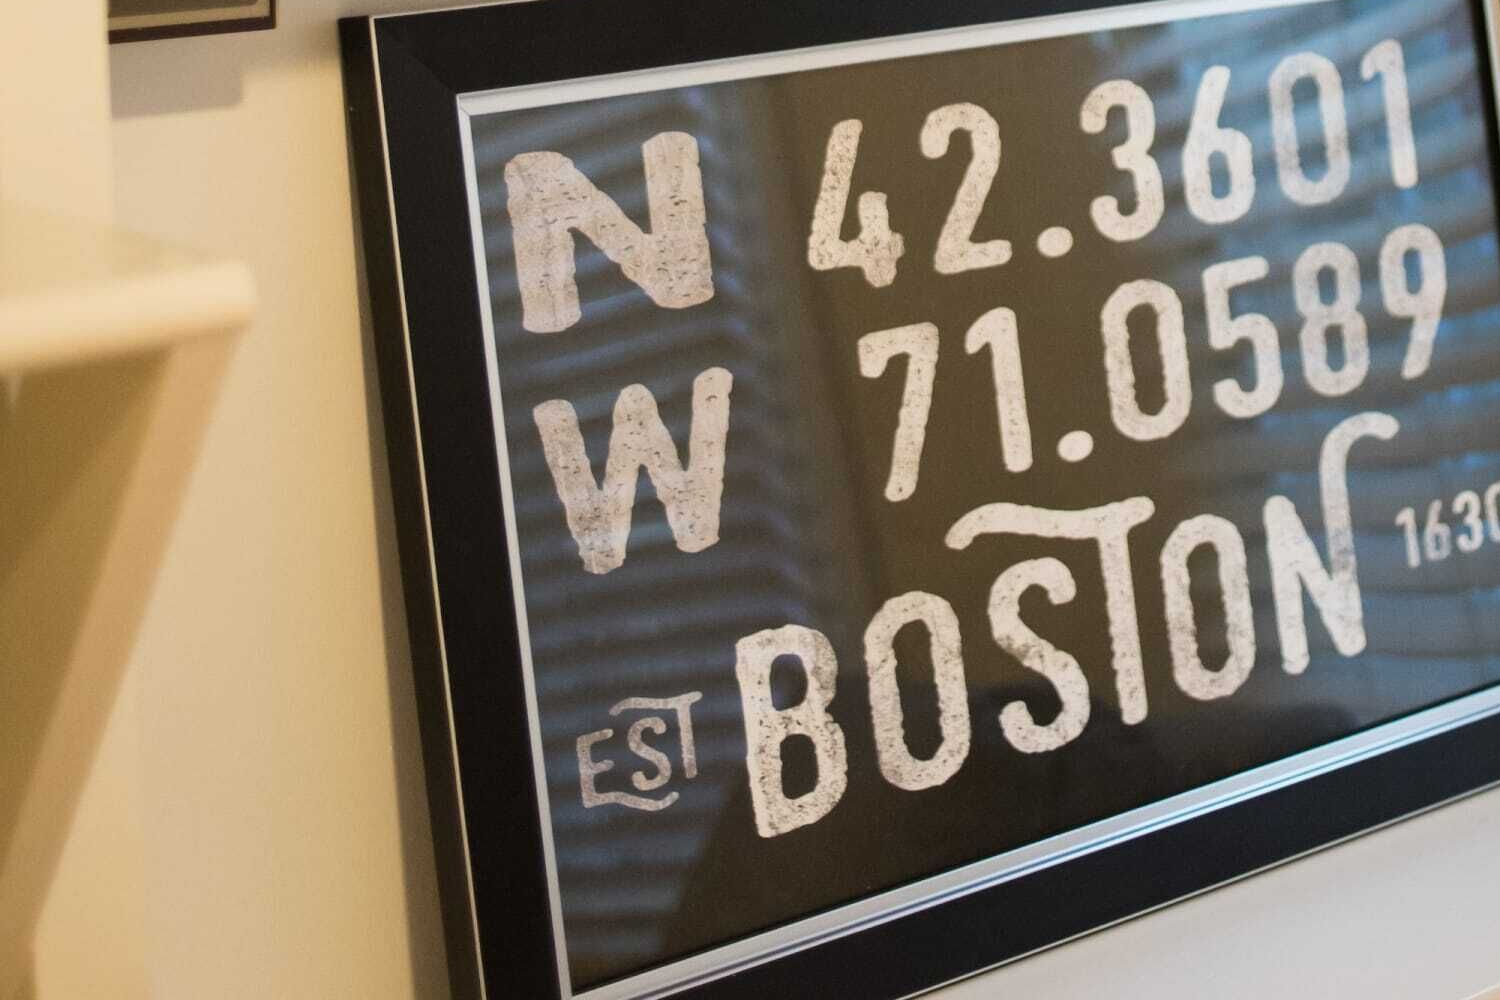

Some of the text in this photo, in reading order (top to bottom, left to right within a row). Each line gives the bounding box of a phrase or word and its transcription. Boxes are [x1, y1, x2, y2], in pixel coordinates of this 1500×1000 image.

[504, 39, 1418, 333] N 42.3601
[532, 223, 1447, 575] W 71.0589
[576, 691, 703, 812] EST
[734, 413, 1399, 838] BOSTON
